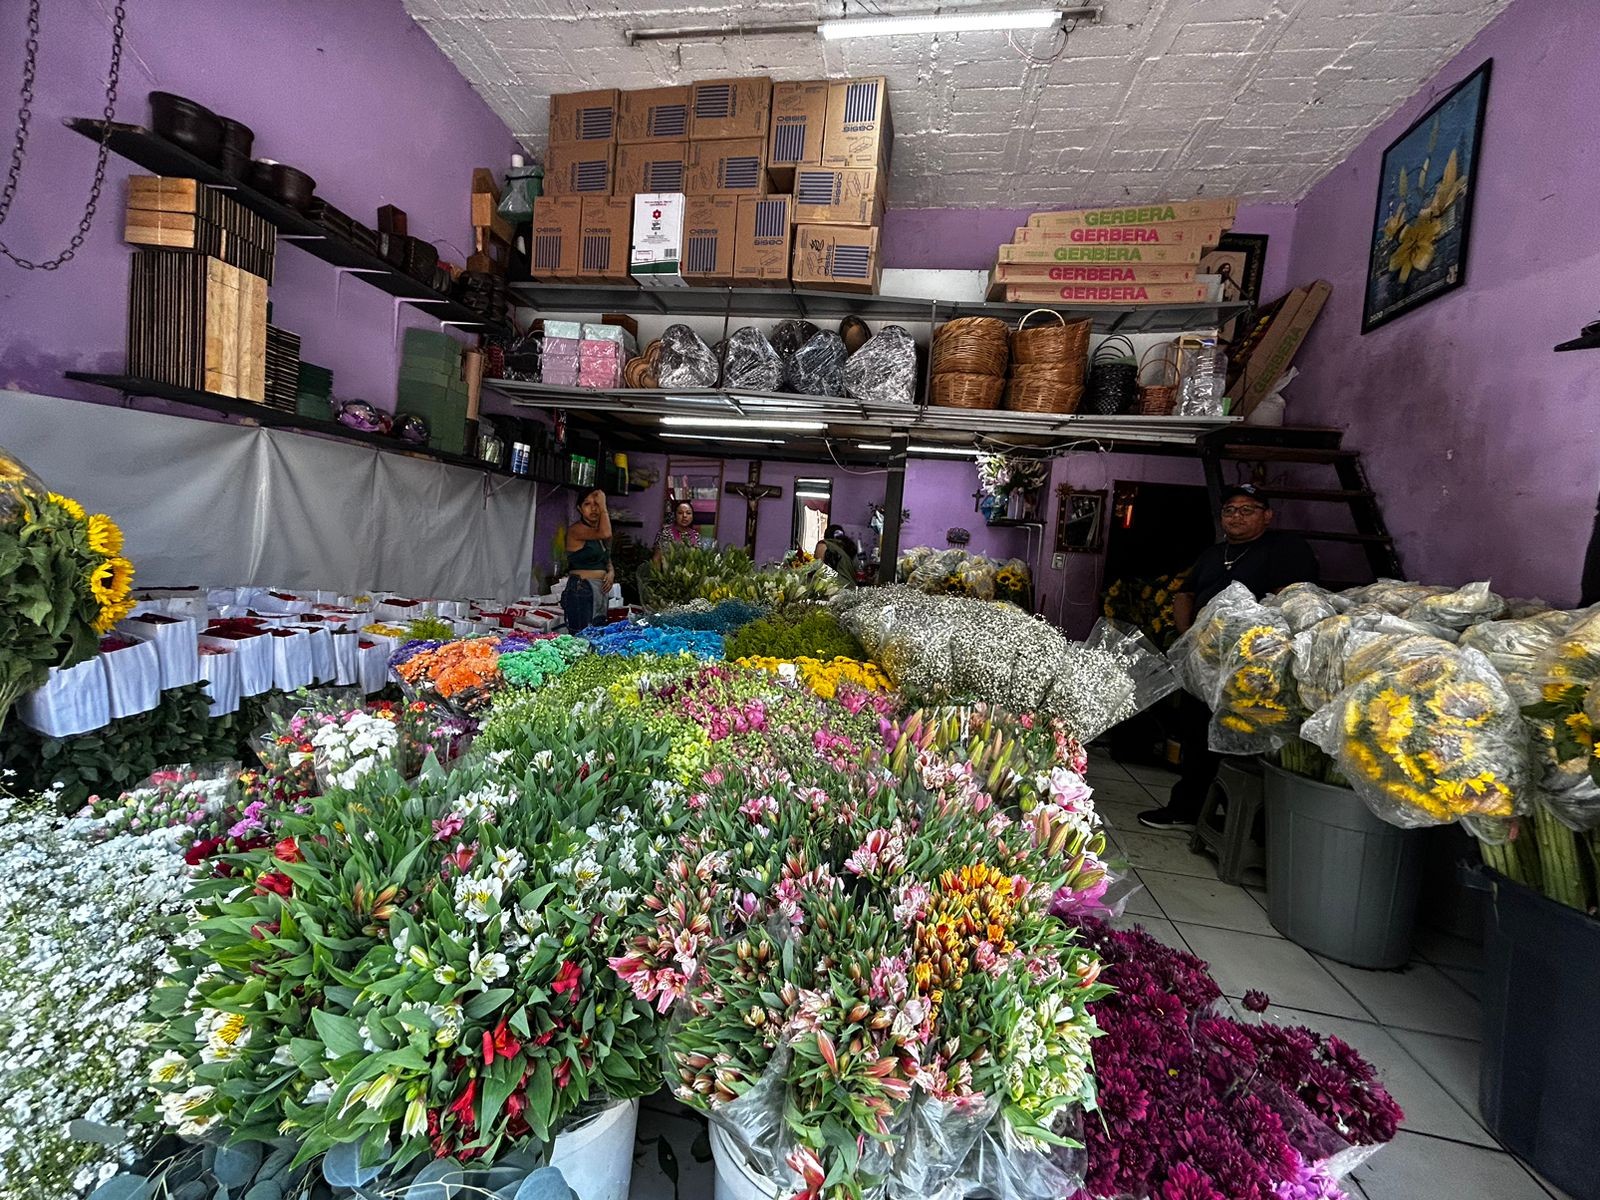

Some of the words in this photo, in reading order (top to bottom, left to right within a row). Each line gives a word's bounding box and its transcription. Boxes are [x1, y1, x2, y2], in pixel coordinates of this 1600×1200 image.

[1084, 205, 1176, 227] GERBERA
[1070, 228, 1160, 243] GERBERA
[1054, 247, 1142, 261] GERBERA
[1048, 267, 1136, 281] GERBERA
[1060, 286, 1148, 300] GERBERA
